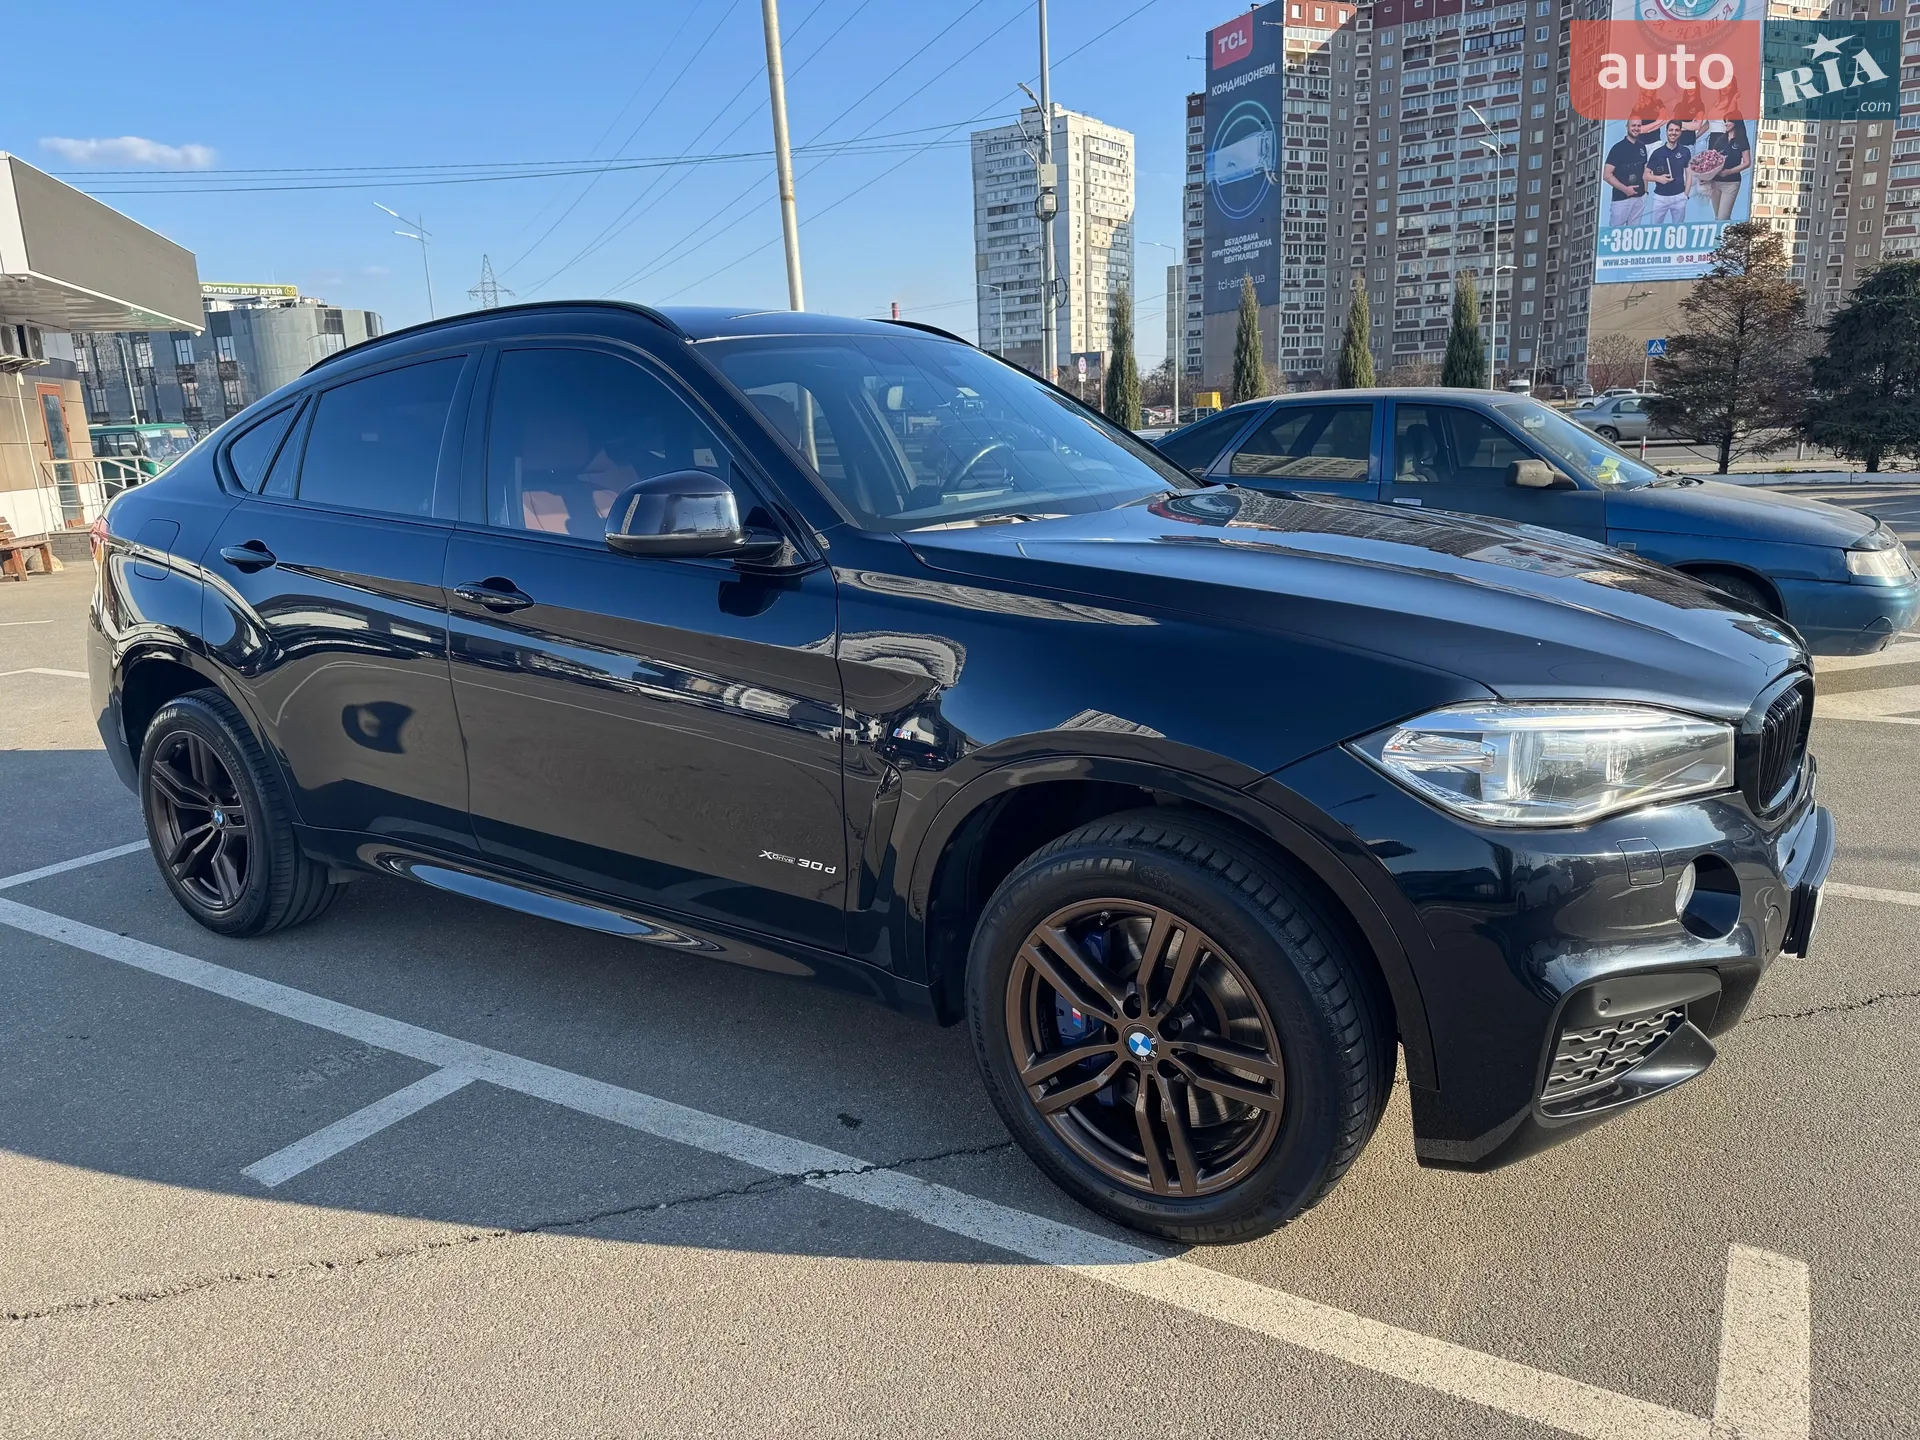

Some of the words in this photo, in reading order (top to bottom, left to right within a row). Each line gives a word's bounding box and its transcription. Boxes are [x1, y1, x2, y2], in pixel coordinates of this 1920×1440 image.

[1218, 29, 1247, 54] TCL
[1211, 62, 1276, 97] КОНДИЦІОНЕРИ
[1211, 238, 1272, 258] ПРИТОЧНО-ВИТЯЖНА
[1224, 232, 1259, 246] ВБУДОВАНА
[1600, 226, 1662, 252] +38077
[1664, 225, 1687, 249] 60
[1691, 223, 1717, 248] 777
[1223, 249, 1259, 264] ВЕНТИЛЯЦІЯ
[1602, 256, 1671, 267] www.sa-nata.com.ua
[1010, 857, 1133, 909] MICHELIN
